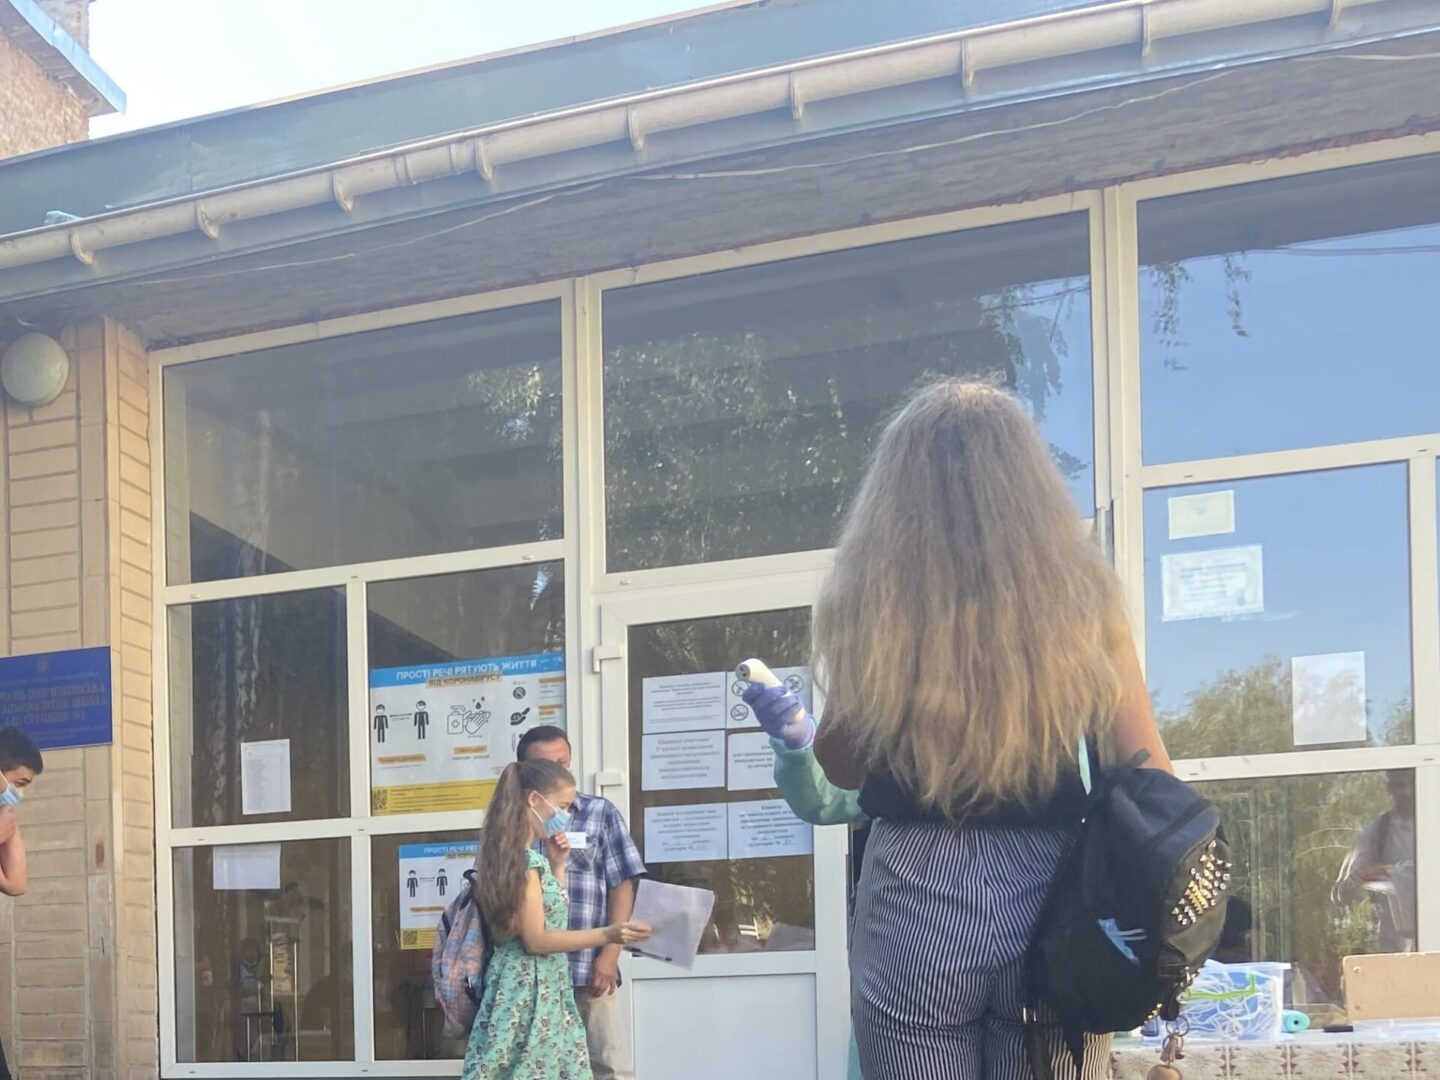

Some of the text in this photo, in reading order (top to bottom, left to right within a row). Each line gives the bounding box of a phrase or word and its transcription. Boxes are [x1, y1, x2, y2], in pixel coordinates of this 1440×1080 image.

[396, 659, 537, 681] ПРОСТІ РЕЧІ РЯТУЮТЬ ЖИТТЯ
